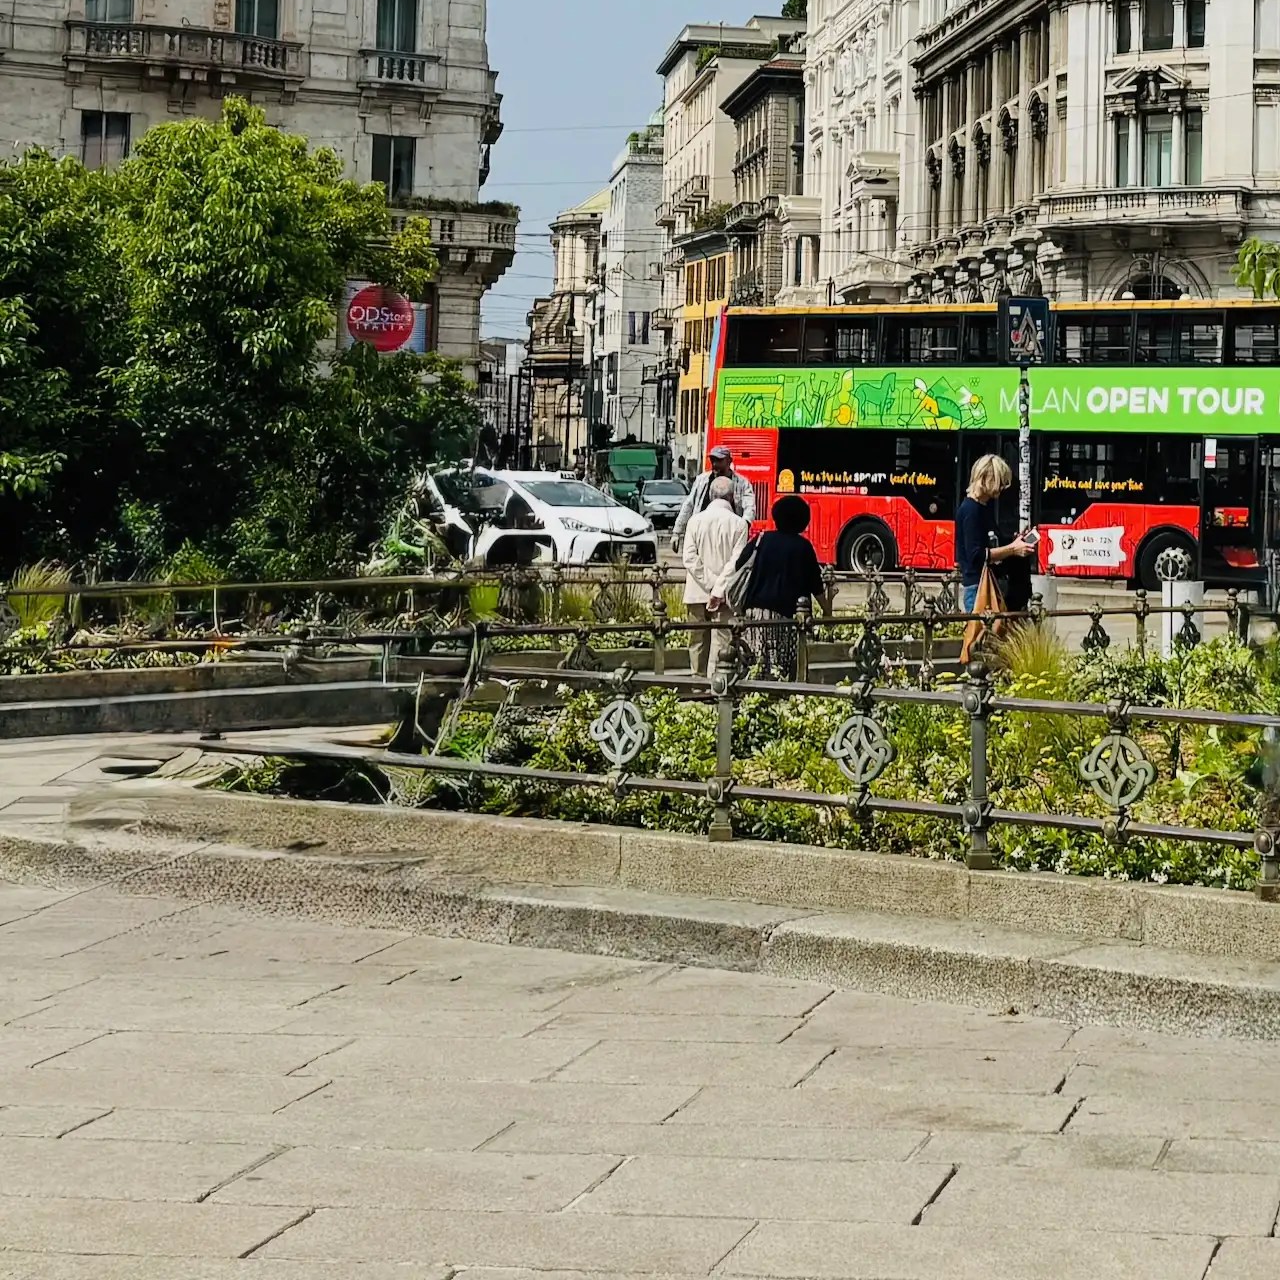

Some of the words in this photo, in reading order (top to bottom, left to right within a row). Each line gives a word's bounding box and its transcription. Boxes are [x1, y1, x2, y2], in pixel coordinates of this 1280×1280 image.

[1000, 387, 1080, 414] MLAN
[1086, 387, 1168, 414] OPEN
[1177, 387, 1265, 415] TOUR
